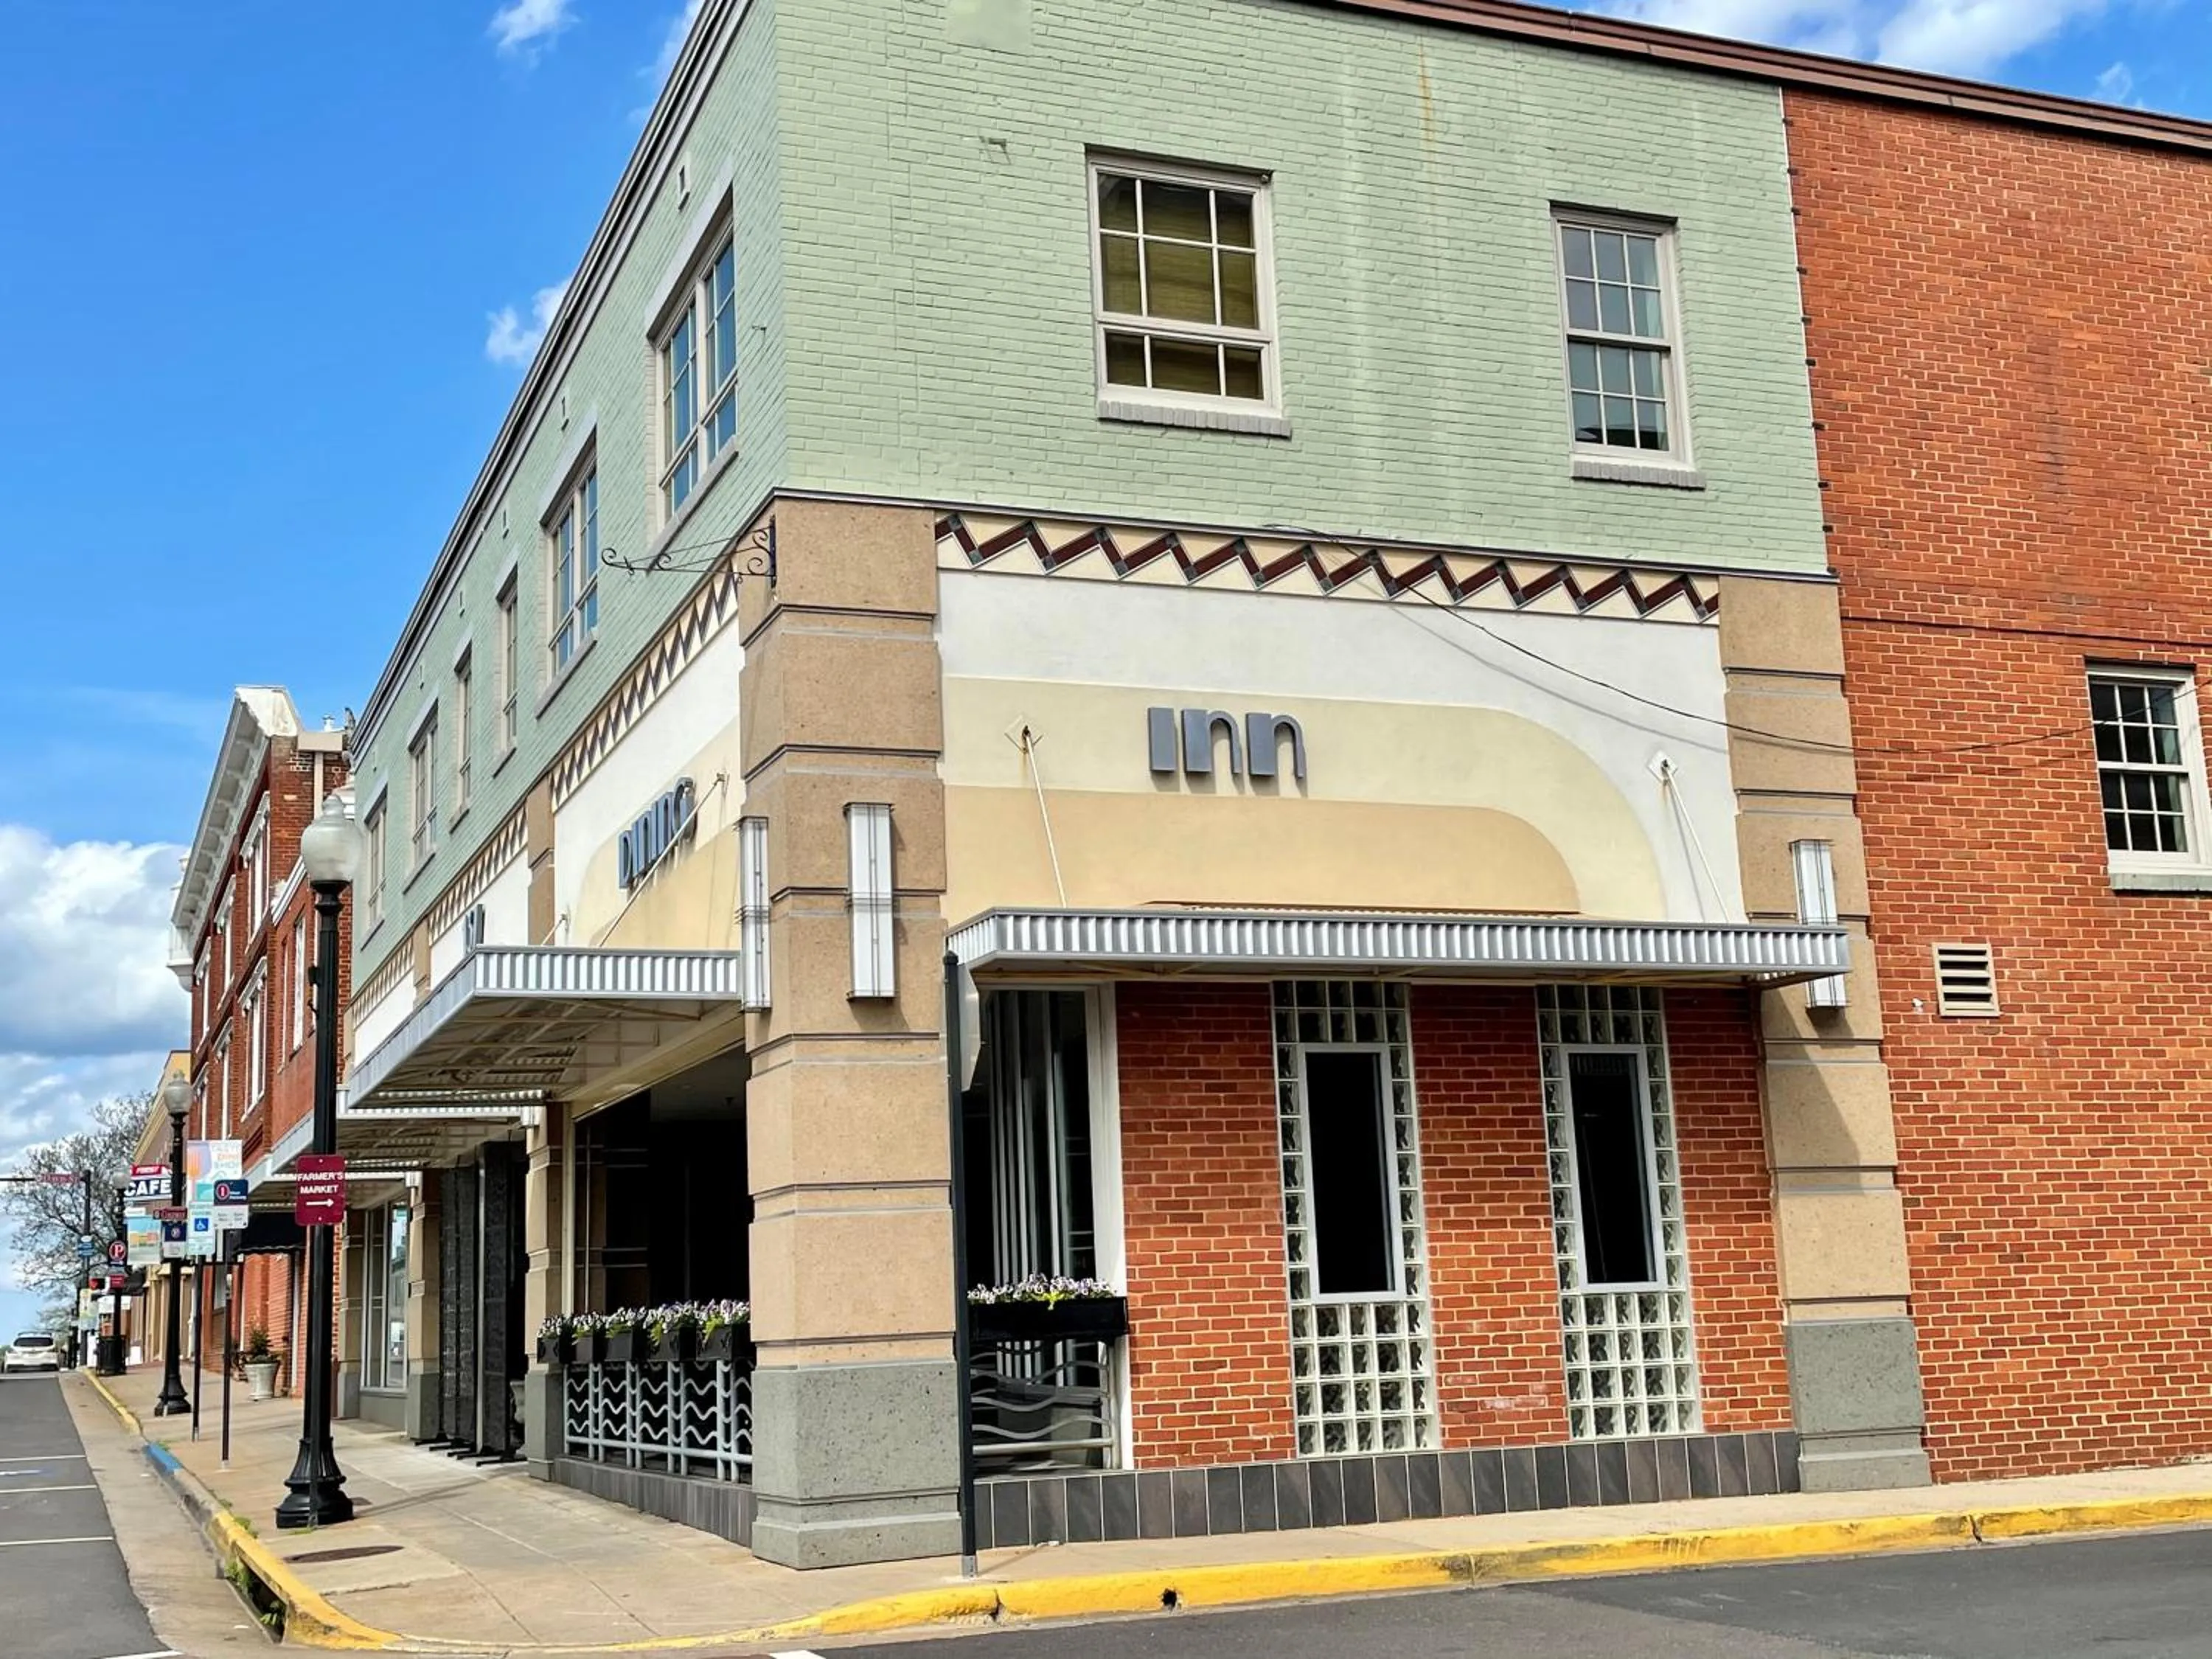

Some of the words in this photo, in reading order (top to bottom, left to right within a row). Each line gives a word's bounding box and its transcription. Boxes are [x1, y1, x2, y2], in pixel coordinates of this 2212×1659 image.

[297, 1171, 344, 1181] FARMER'S
[123, 1179, 172, 1197] CAFE
[300, 1184, 338, 1194] MARKET
[114, 1244, 124, 1258] P
